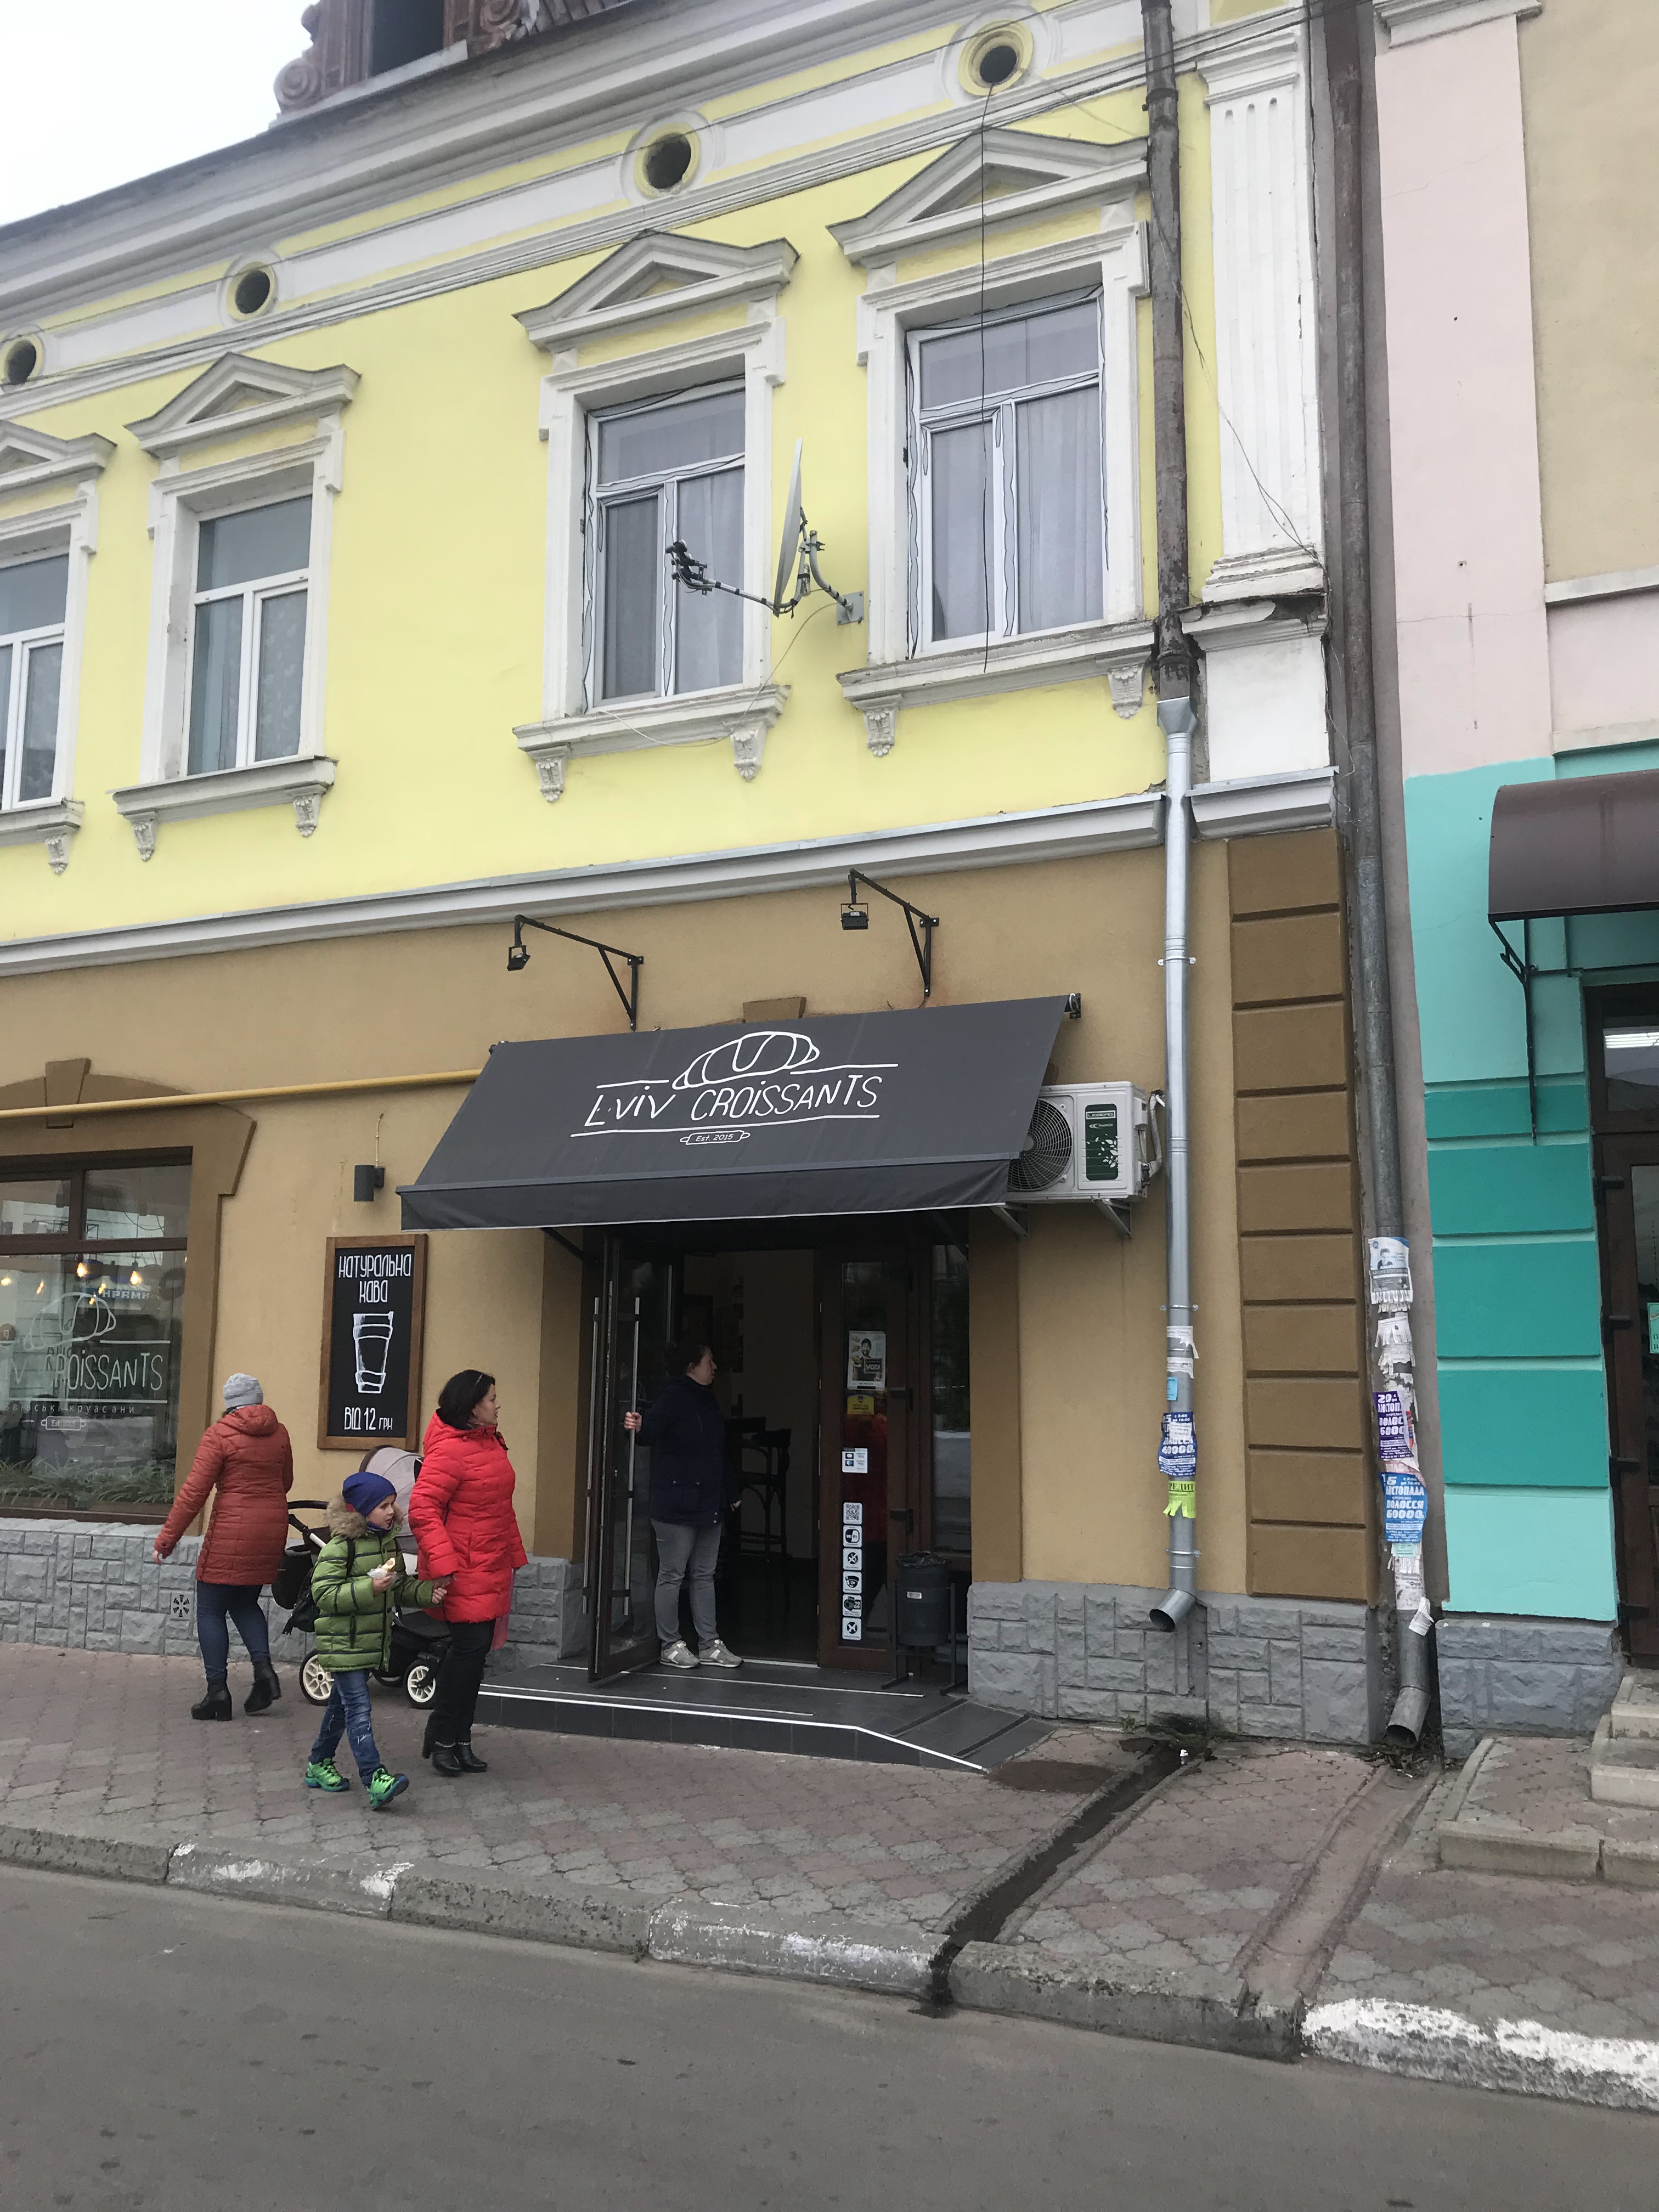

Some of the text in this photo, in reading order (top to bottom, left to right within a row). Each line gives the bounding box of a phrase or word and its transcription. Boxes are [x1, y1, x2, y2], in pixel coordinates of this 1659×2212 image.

[344, 1407, 362, 1430] ВІД
[364, 1407, 376, 1430] 12
[1169, 1482, 1194, 1491] РЕДИТ
